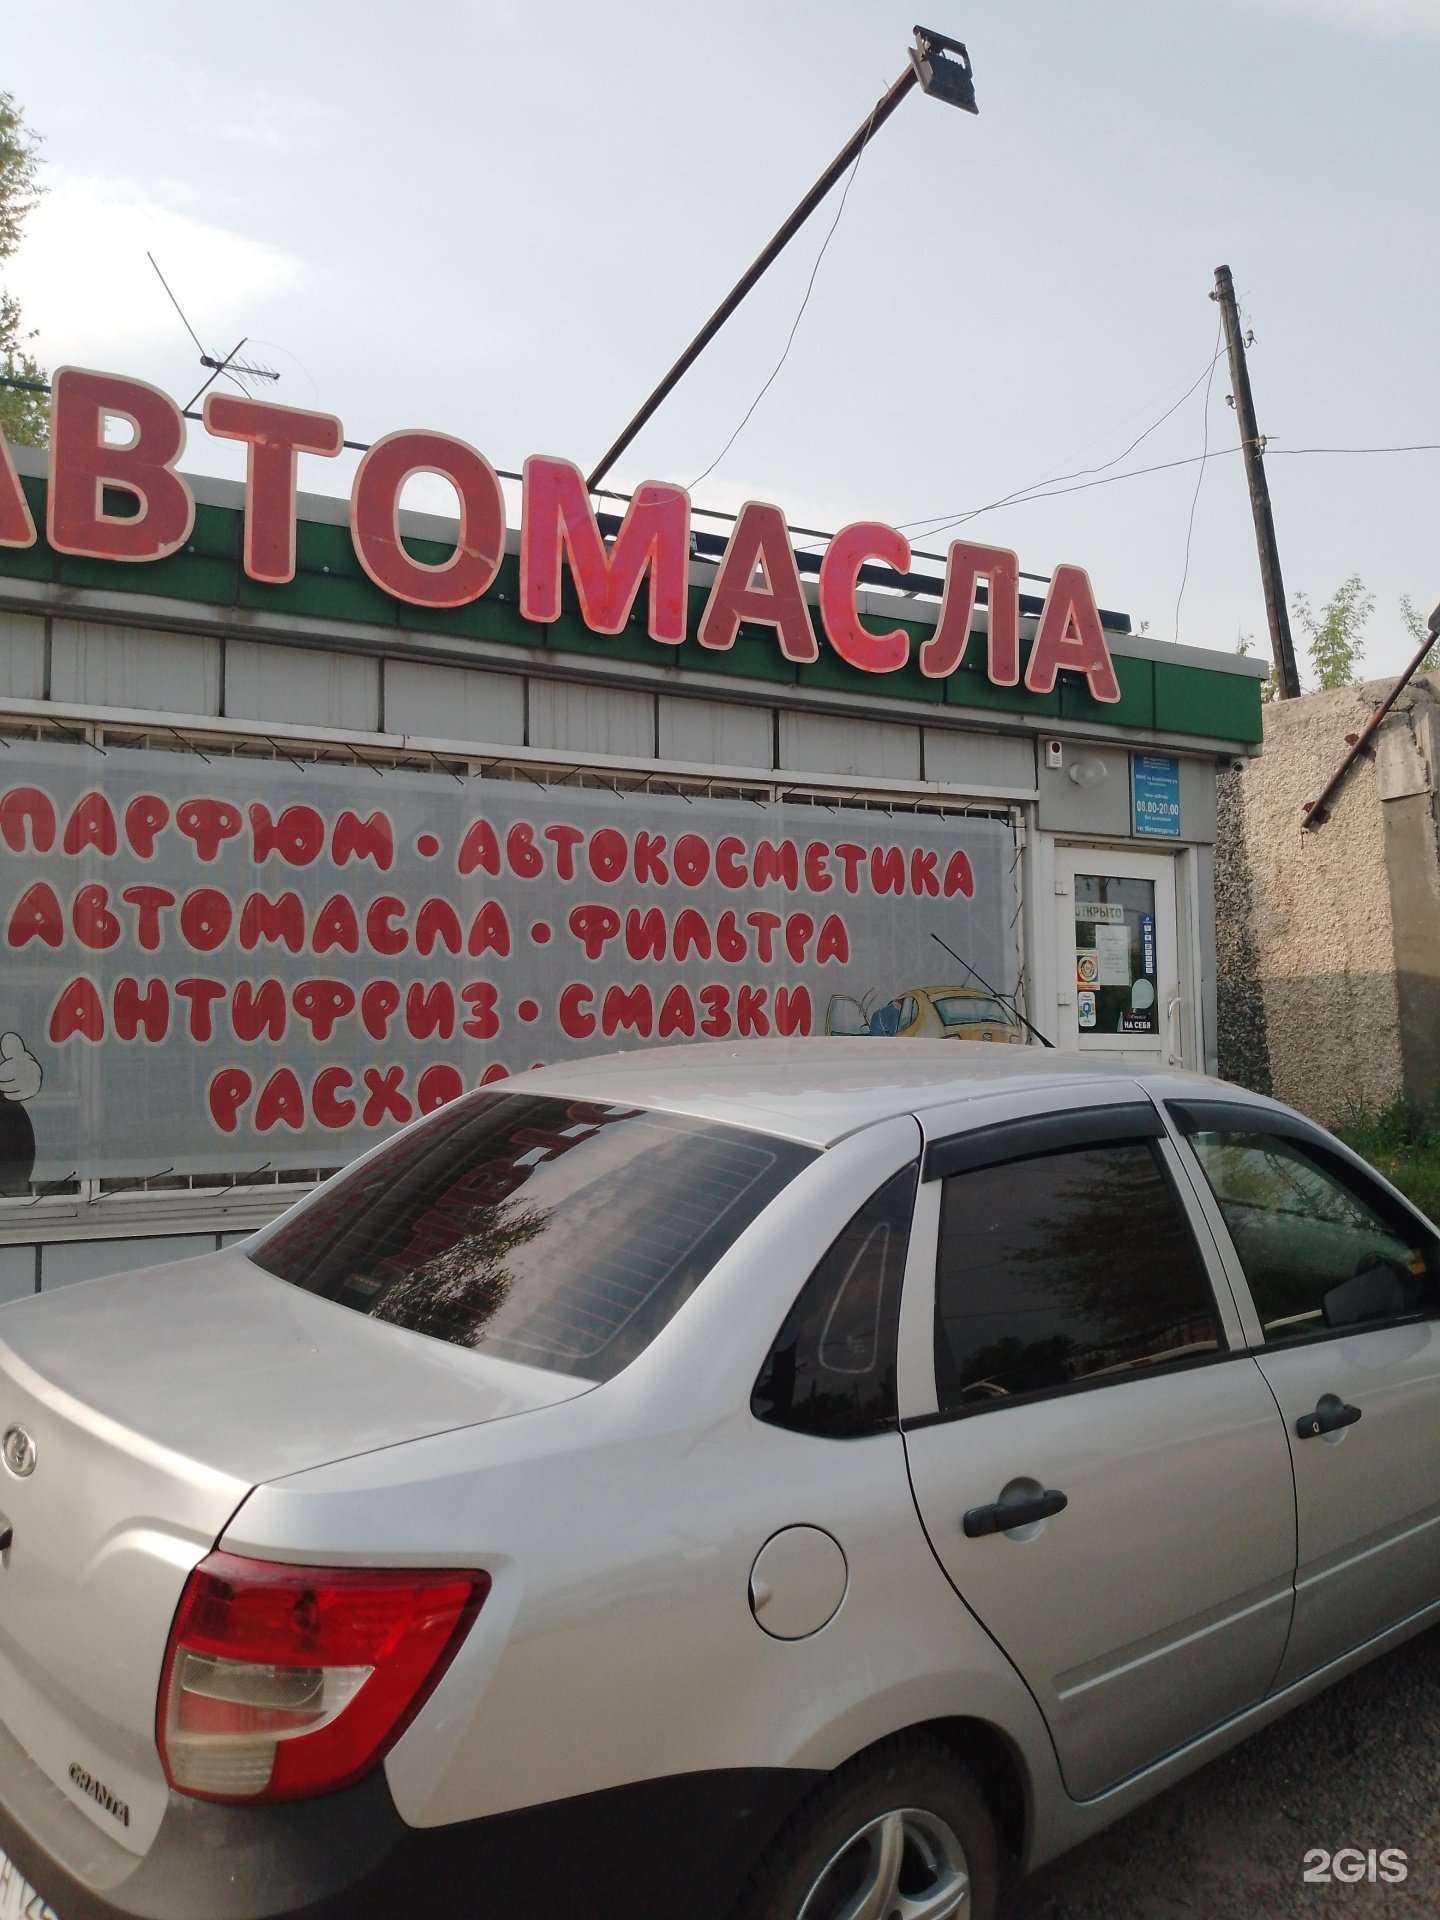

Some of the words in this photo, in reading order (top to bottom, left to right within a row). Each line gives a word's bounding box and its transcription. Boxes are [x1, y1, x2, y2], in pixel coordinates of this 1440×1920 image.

[0, 786, 395, 872] ПАРФЮМ
[457, 818, 975, 899] АВТОКОСМЕТИКА
[7, 881, 511, 958] АВТОМАСЛА
[568, 904, 850, 965] ФИЛЬТРА
[48, 976, 501, 1043] АНТИФРИЗ
[558, 983, 813, 1040] СМАЗКИ
[1124, 1021, 1134, 1029] НА
